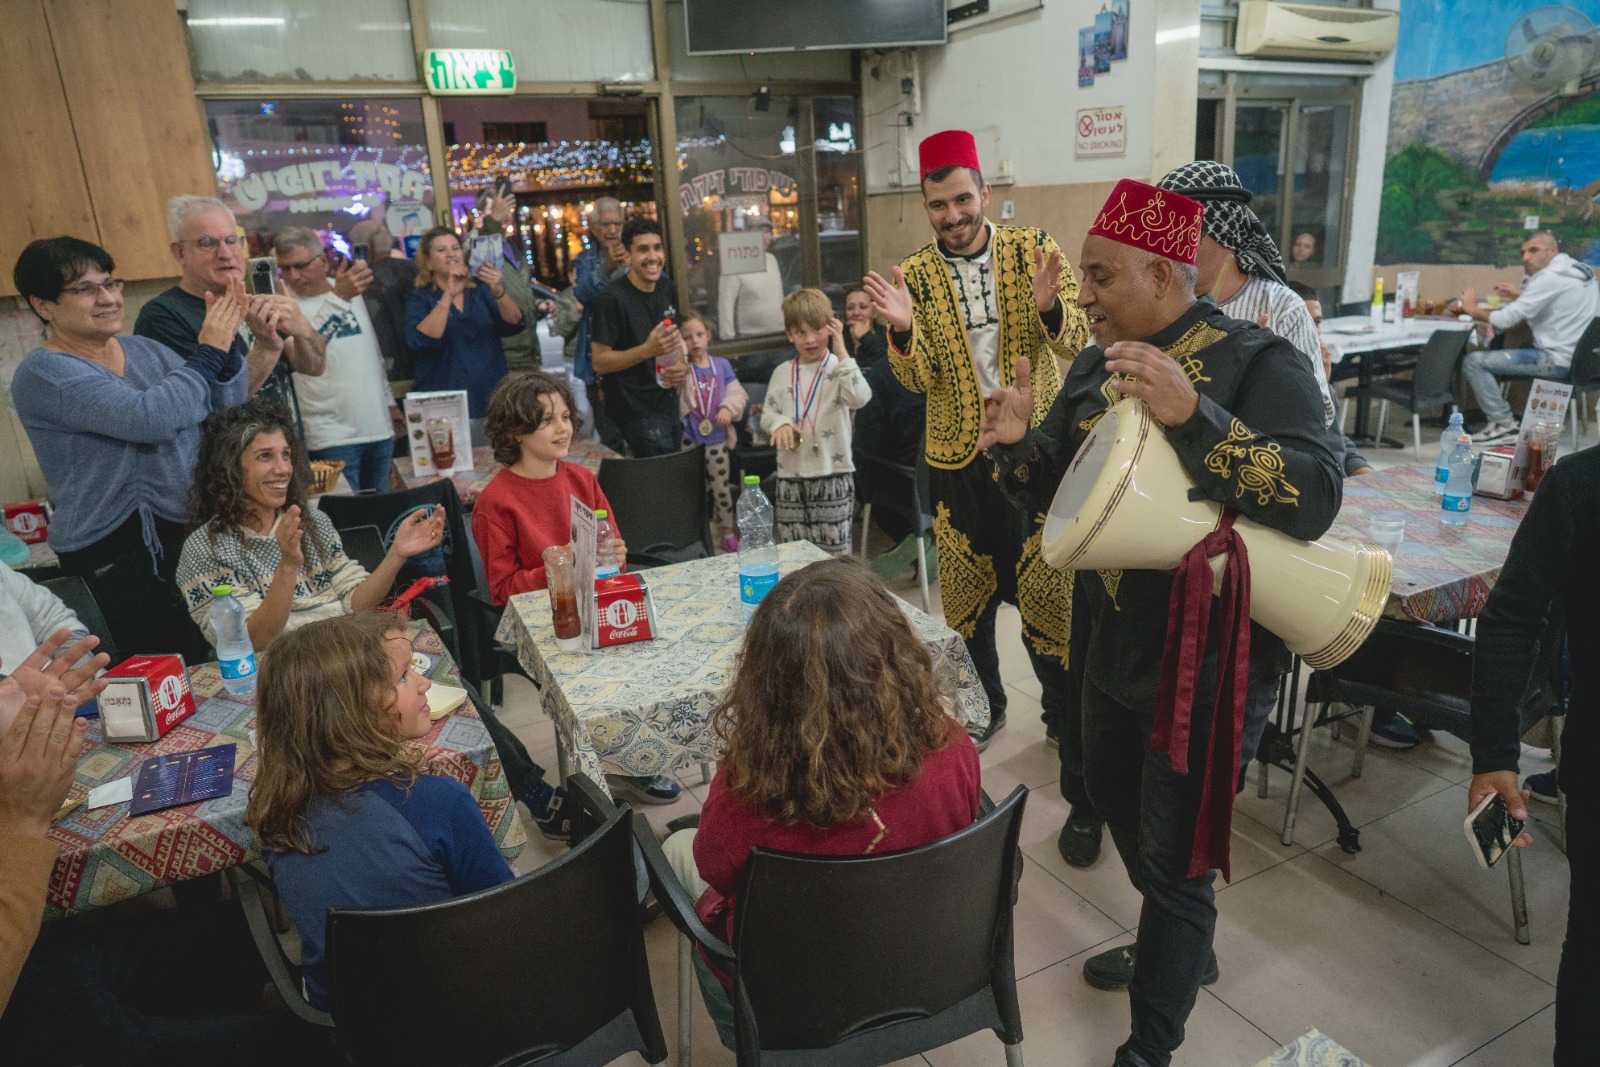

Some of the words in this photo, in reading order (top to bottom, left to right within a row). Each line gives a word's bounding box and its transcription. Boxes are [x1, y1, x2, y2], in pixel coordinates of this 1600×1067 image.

[434, 51, 511, 89] יציאה
[1095, 112, 1121, 121] אסור
[1094, 123, 1123, 136] לעשן
[1078, 142, 1088, 150] NO
[1090, 140, 1122, 149] SMOKING
[728, 245, 760, 259] פתוח
